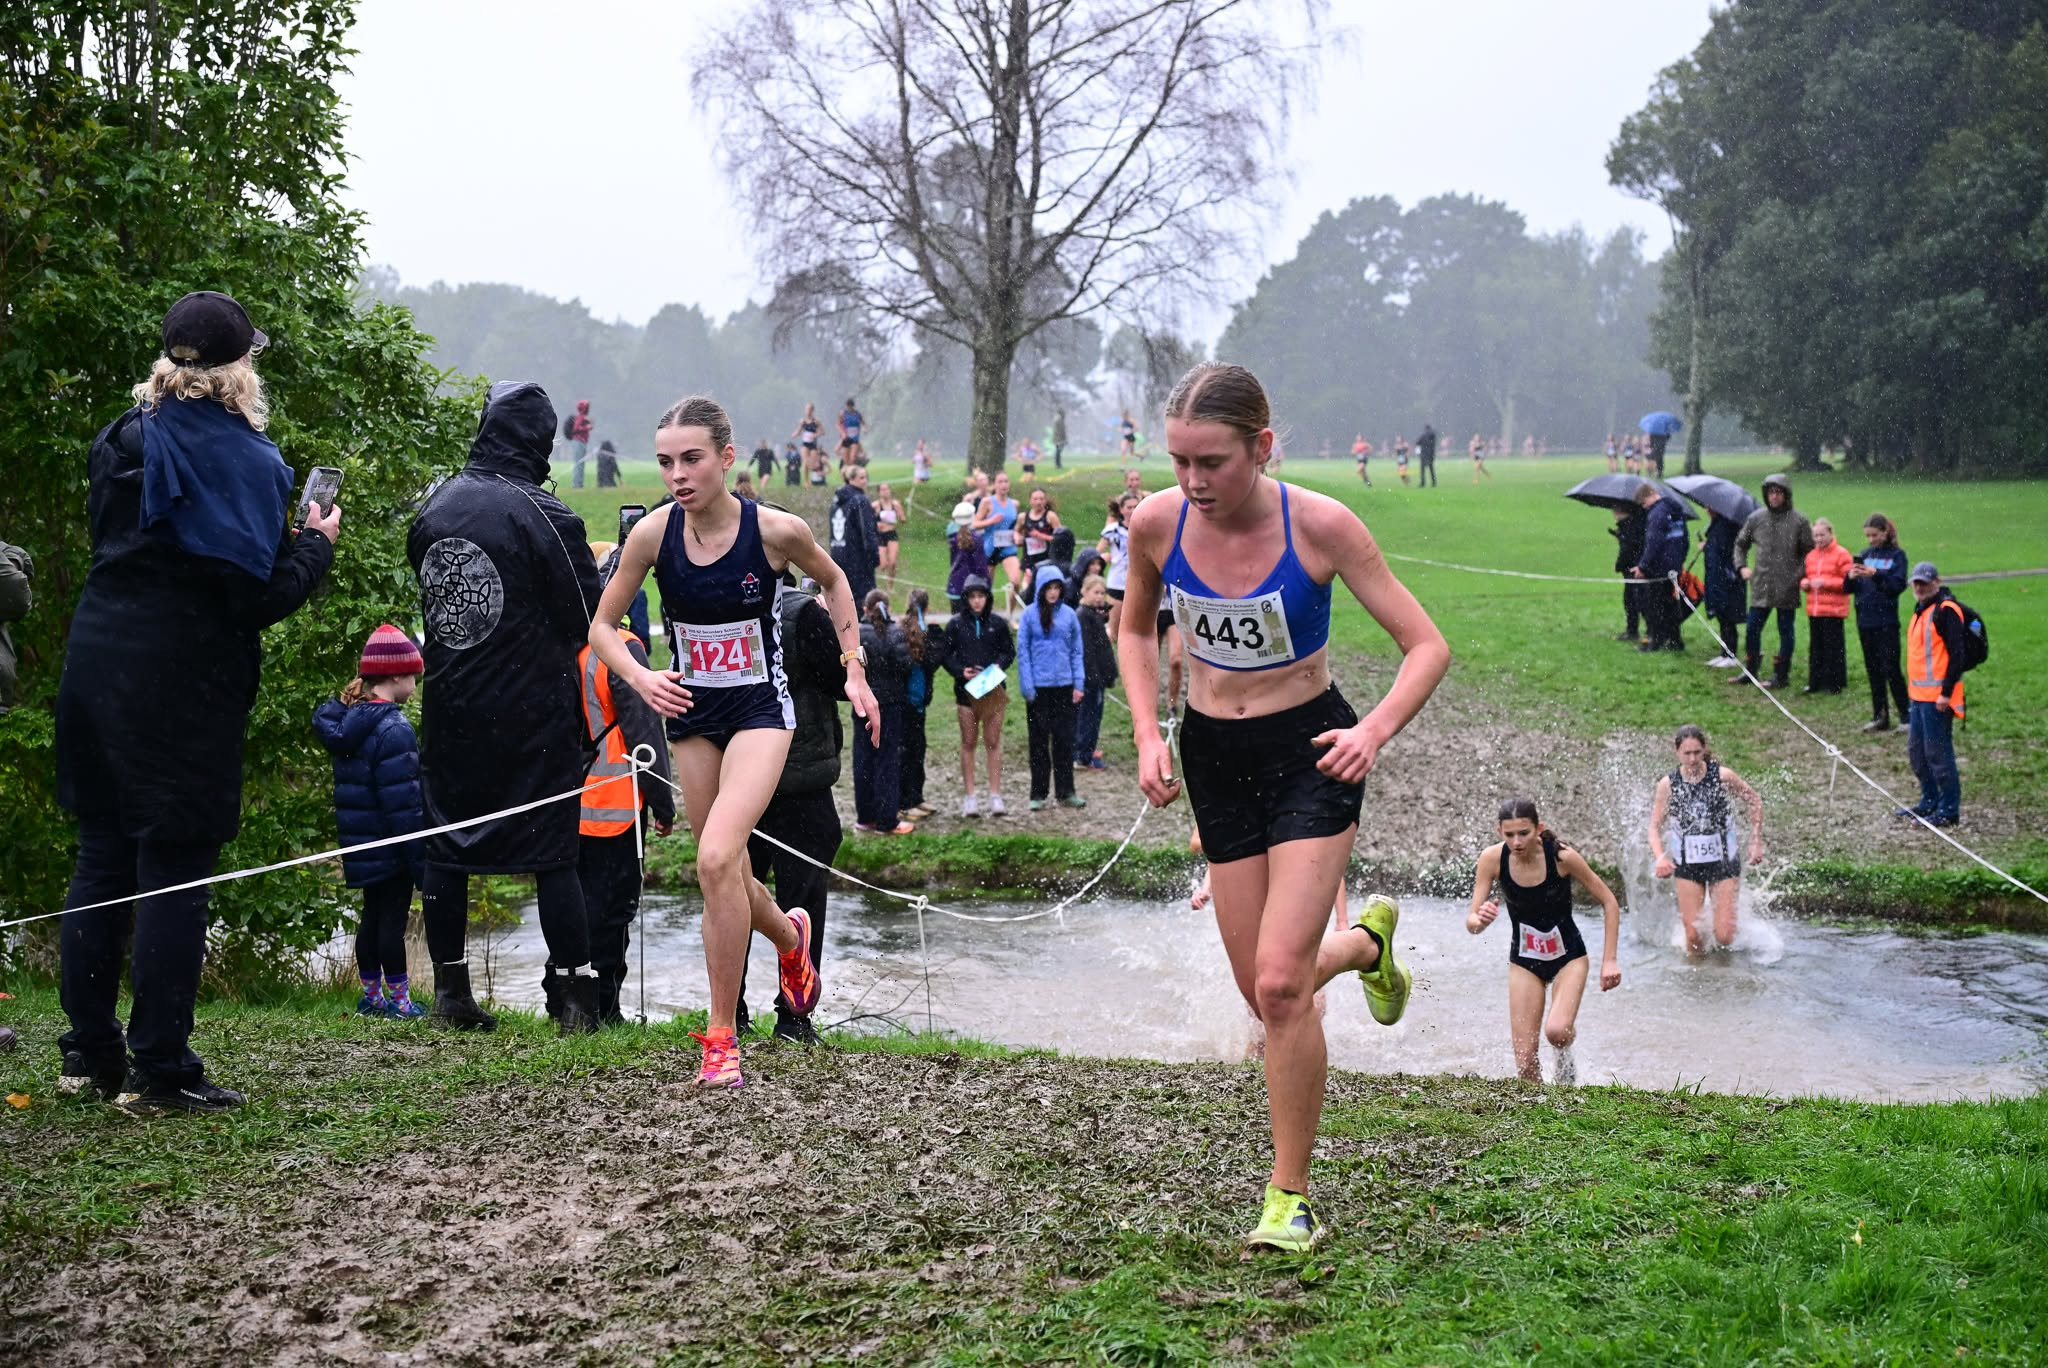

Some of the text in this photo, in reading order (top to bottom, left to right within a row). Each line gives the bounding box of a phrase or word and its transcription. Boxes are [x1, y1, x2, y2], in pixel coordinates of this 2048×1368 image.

[1195, 613, 1265, 649] 443
[693, 638, 747, 671] 124
[1533, 936, 1549, 953] 61
[180, 1088, 209, 1102] MERRELL
